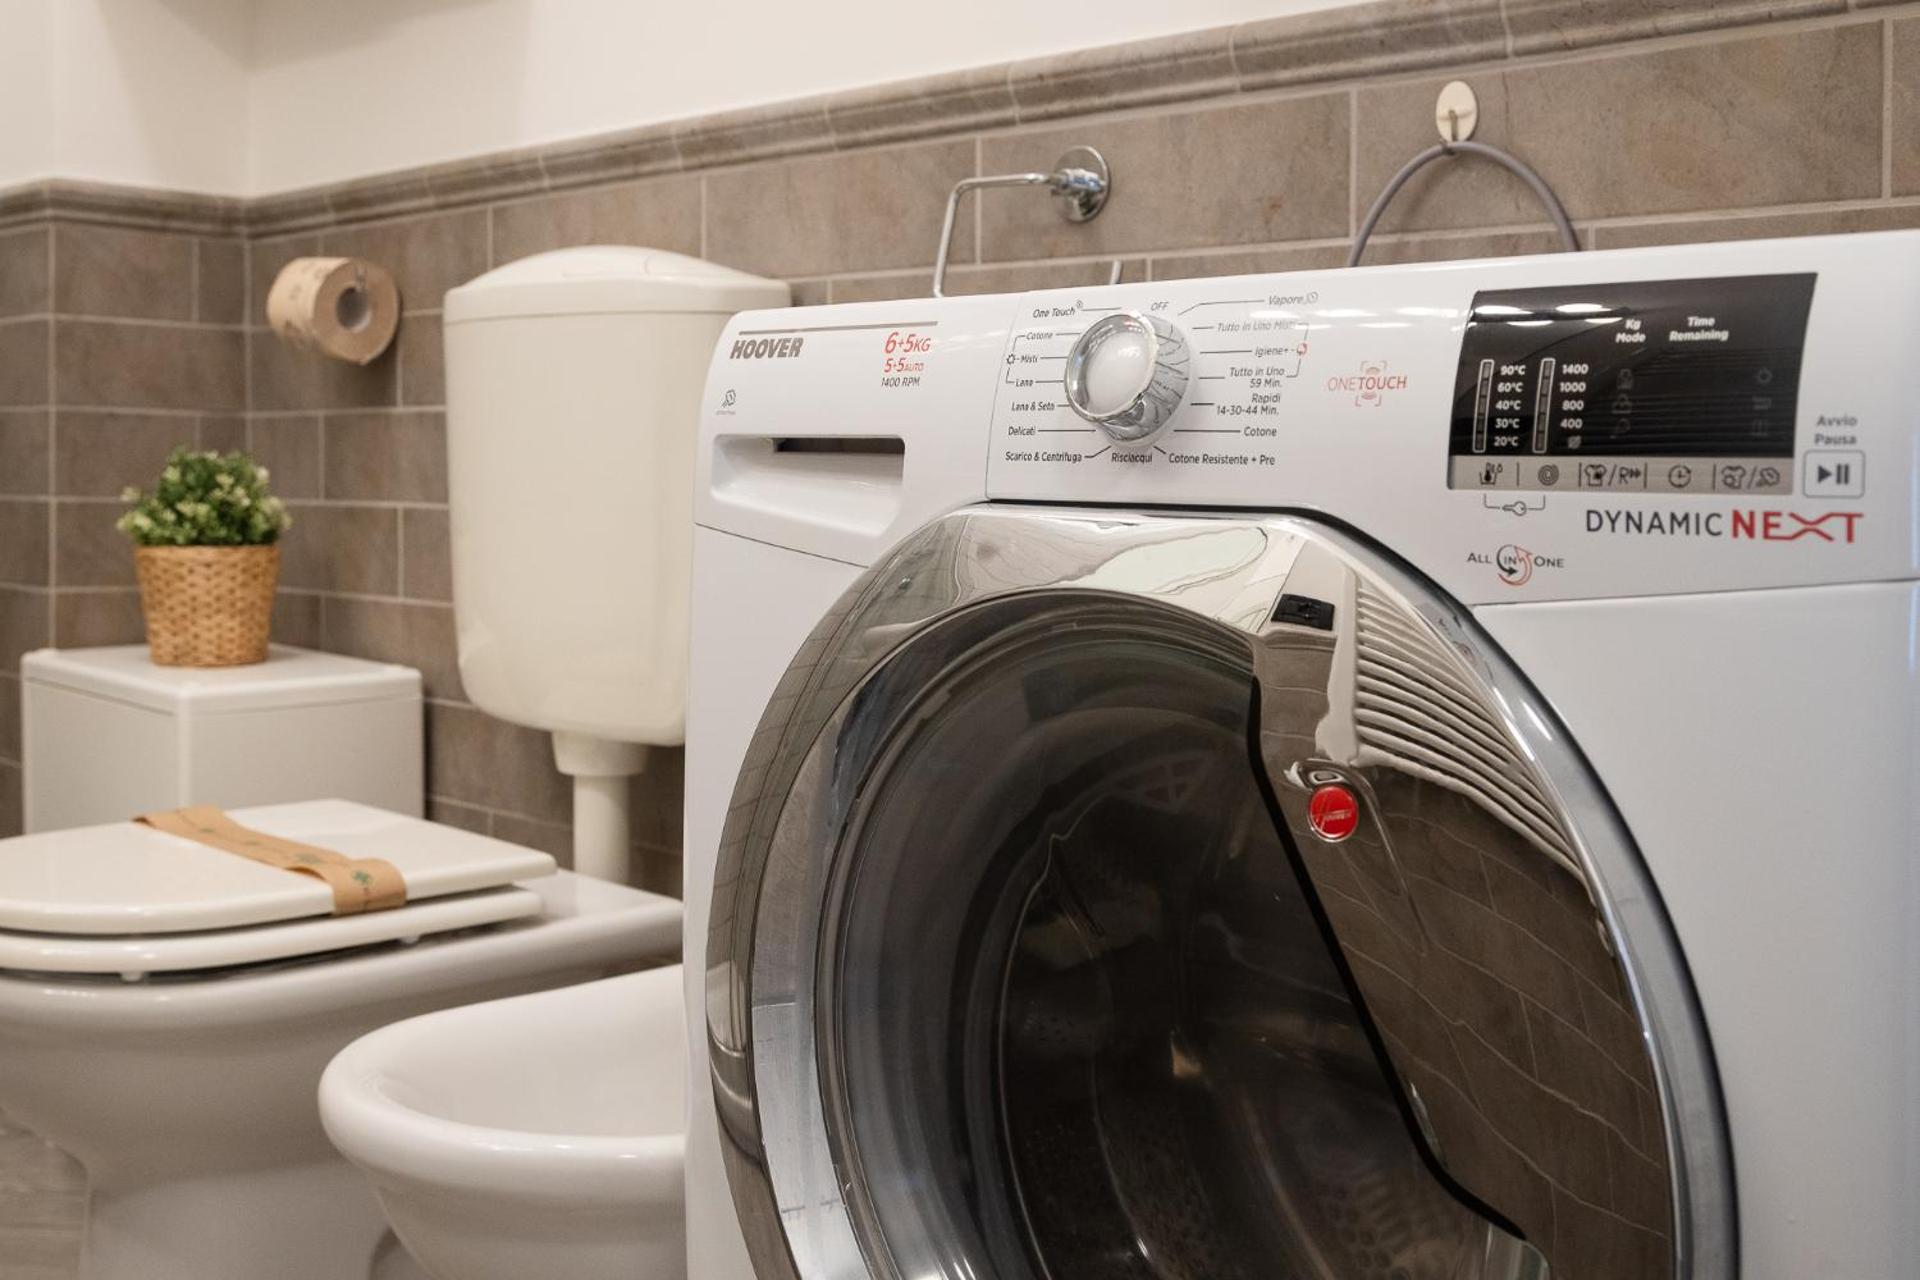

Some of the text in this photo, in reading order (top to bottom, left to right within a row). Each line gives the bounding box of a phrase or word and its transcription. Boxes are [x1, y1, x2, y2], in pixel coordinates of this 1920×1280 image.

[1150, 301, 1169, 311] OFF
[1269, 296, 1303, 306] Vapore
[1033, 306, 1075, 318] One Touch
[1625, 319, 1642, 330] Kg
[1688, 316, 1715, 326] Time
[1218, 322, 1239, 332] Tutto
[1242, 322, 1251, 331] in
[1026, 332, 1053, 340] Cotone
[1615, 332, 1646, 343] Mode
[1669, 330, 1729, 342] Remaining
[730, 337, 804, 359] HOOVER
[1230, 366, 1284, 377] Tutto in Uno
[1501, 364, 1526, 376] 90°C
[1562, 364, 1588, 374] 1400
[881, 376, 920, 387] 1400 RPM
[1016, 379, 1034, 388] Lana
[1250, 378, 1282, 388] 59 Min.
[1498, 382, 1524, 392] 60°C
[1560, 382, 1586, 392] 1000
[1252, 393, 1281, 404] Rapidi
[1012, 402, 1029, 411] Lana
[1030, 402, 1036, 411] &
[1496, 400, 1521, 410] 40°C
[1562, 400, 1584, 410] 800
[1217, 406, 1279, 416] 14-30-44 Min.
[1495, 418, 1520, 428] 30°C
[1560, 418, 1582, 428] 400
[1816, 414, 1858, 426] Avvio
[1008, 426, 1036, 436] Delicati
[1244, 426, 1277, 436] Cotone
[1494, 436, 1519, 446] 20°C
[1815, 433, 1857, 446] Pausa
[1005, 451, 1082, 464] Scarico & Centrifuga
[1112, 452, 1152, 464] Risciacqui
[1169, 453, 1200, 464] Cotone
[1202, 454, 1248, 464] Resistente
[1260, 454, 1276, 466] Pre
[1586, 510, 1864, 543] DYNAMIC NEXT
